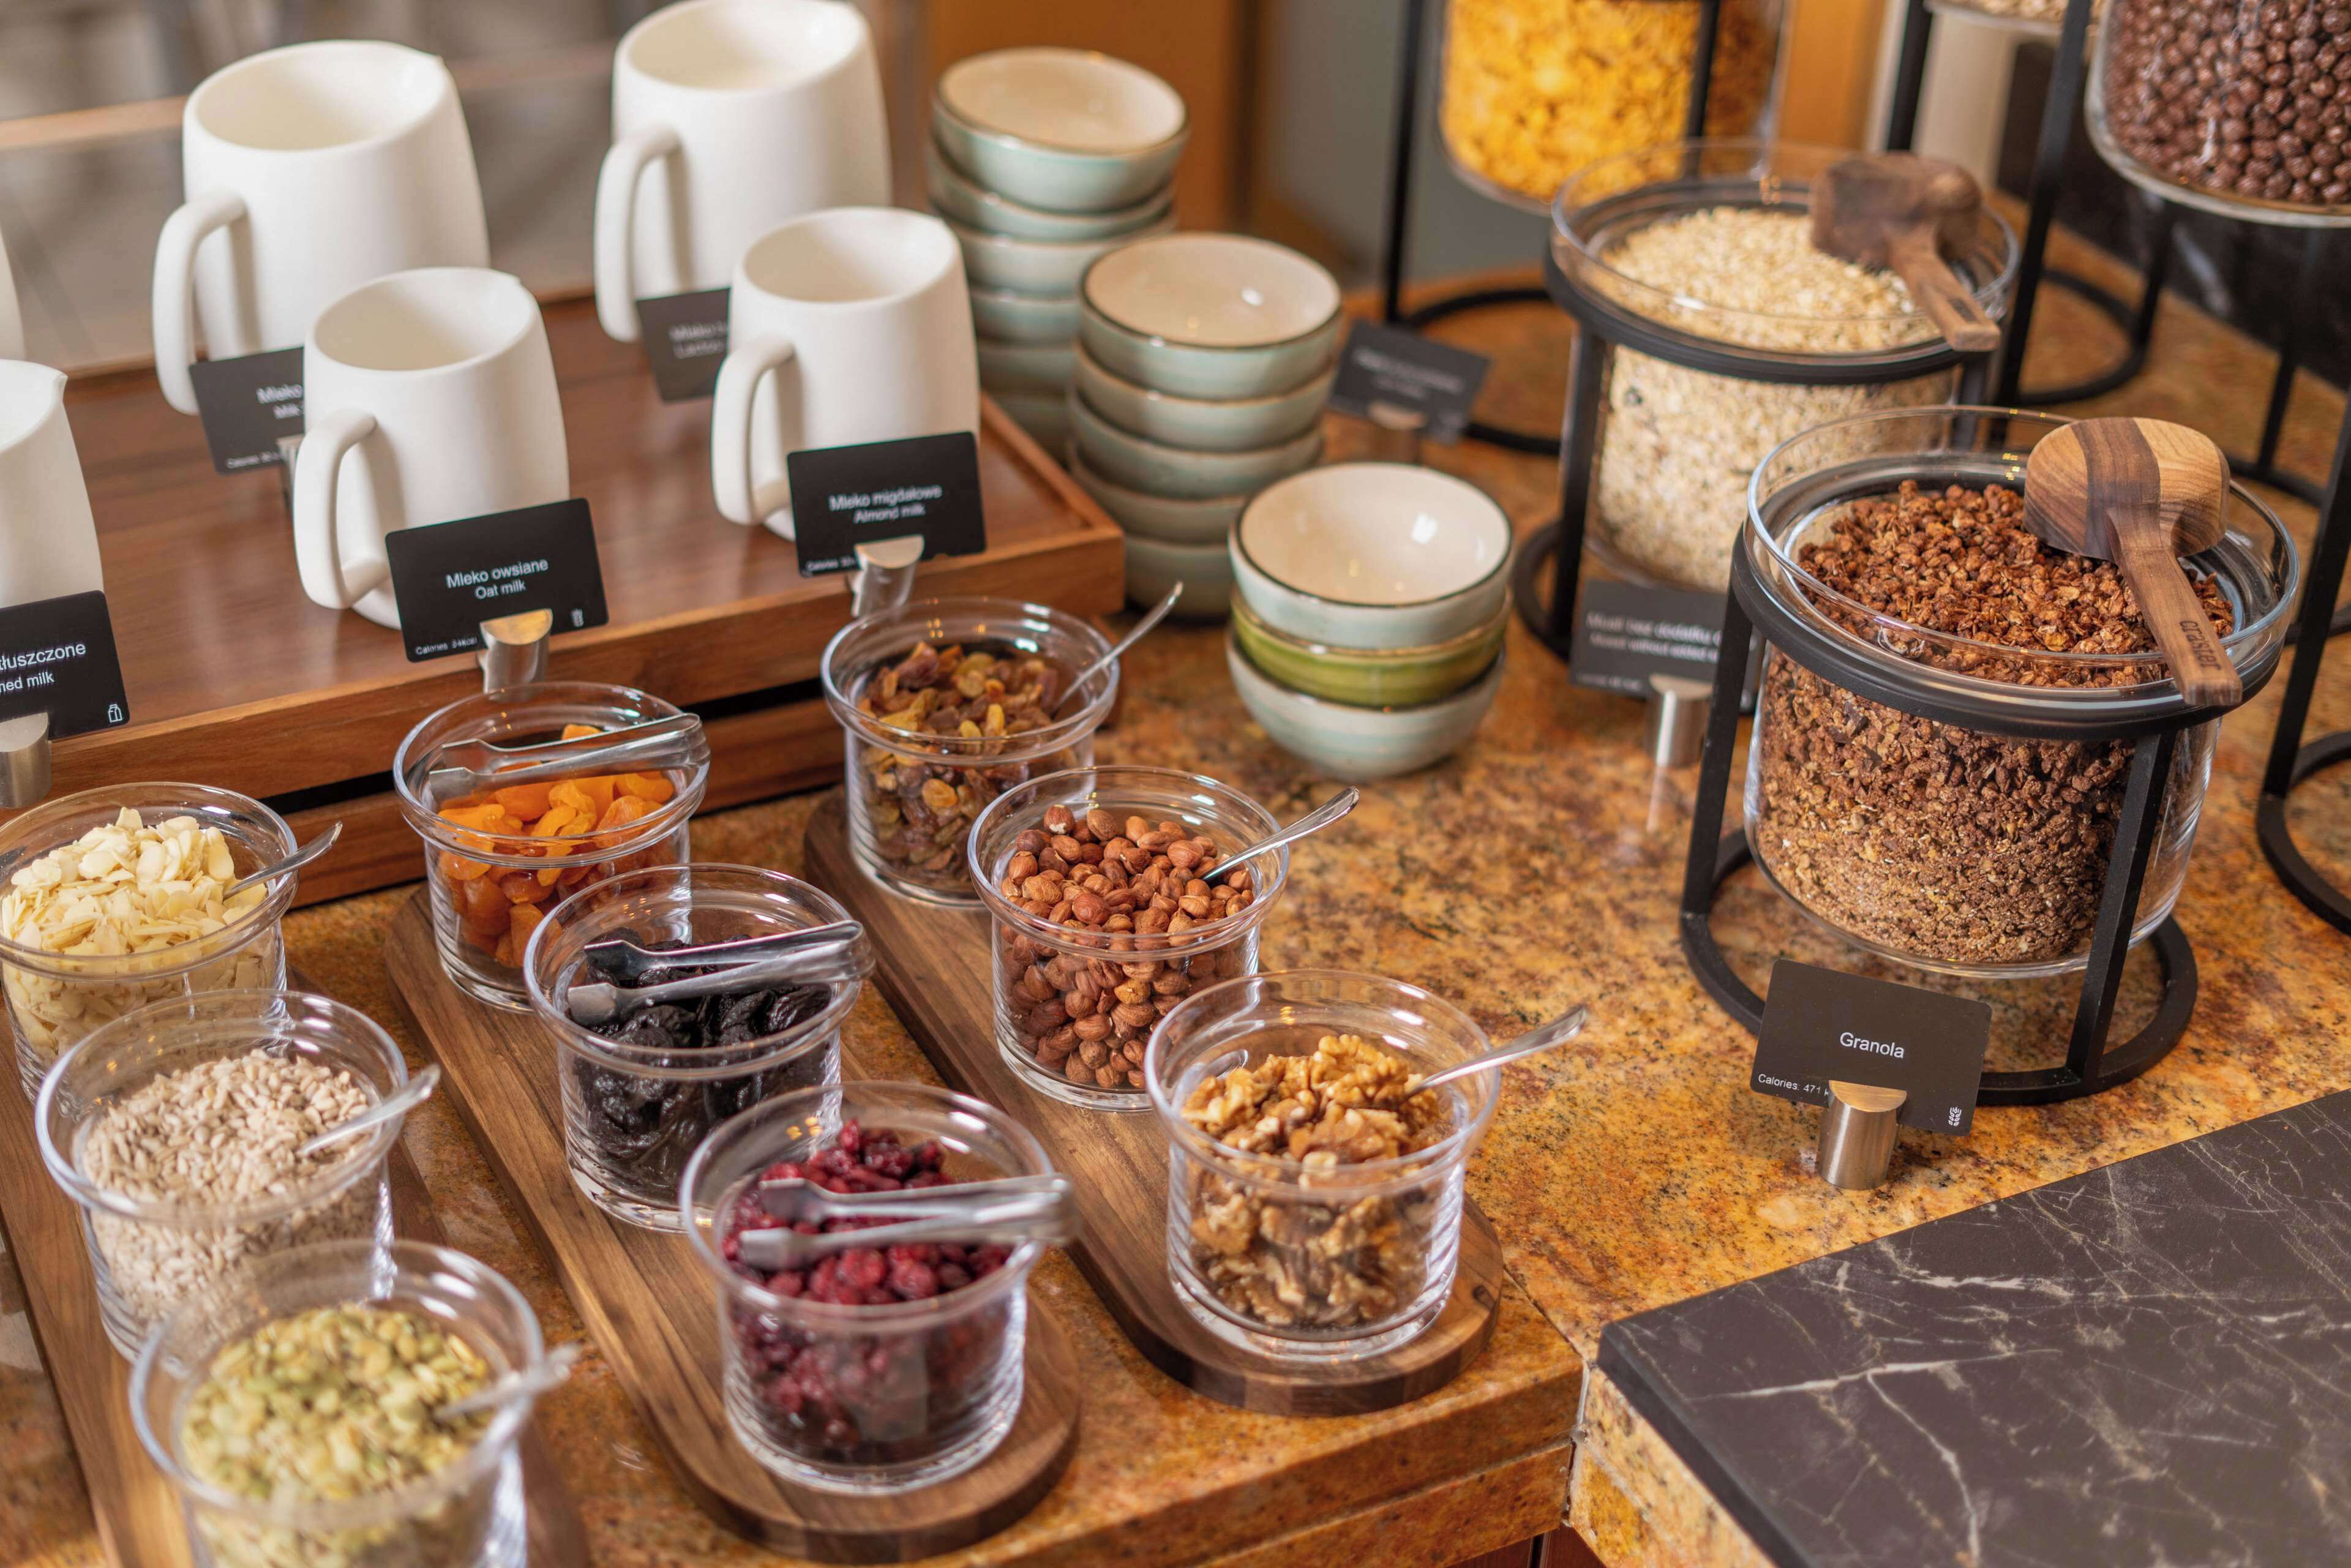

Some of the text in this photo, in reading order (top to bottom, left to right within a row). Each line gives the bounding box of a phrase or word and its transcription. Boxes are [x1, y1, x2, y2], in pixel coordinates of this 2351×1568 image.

[828, 493, 871, 511] Mleko
[853, 502, 926, 524] Almond milk
[446, 559, 549, 588] Mleko owsiane
[474, 579, 527, 599] Oat milk
[2179, 620, 2222, 670] craster
[26, 672, 55, 687] milk
[1840, 1032, 1905, 1059] Granola
[1803, 1084, 1821, 1094] 471
